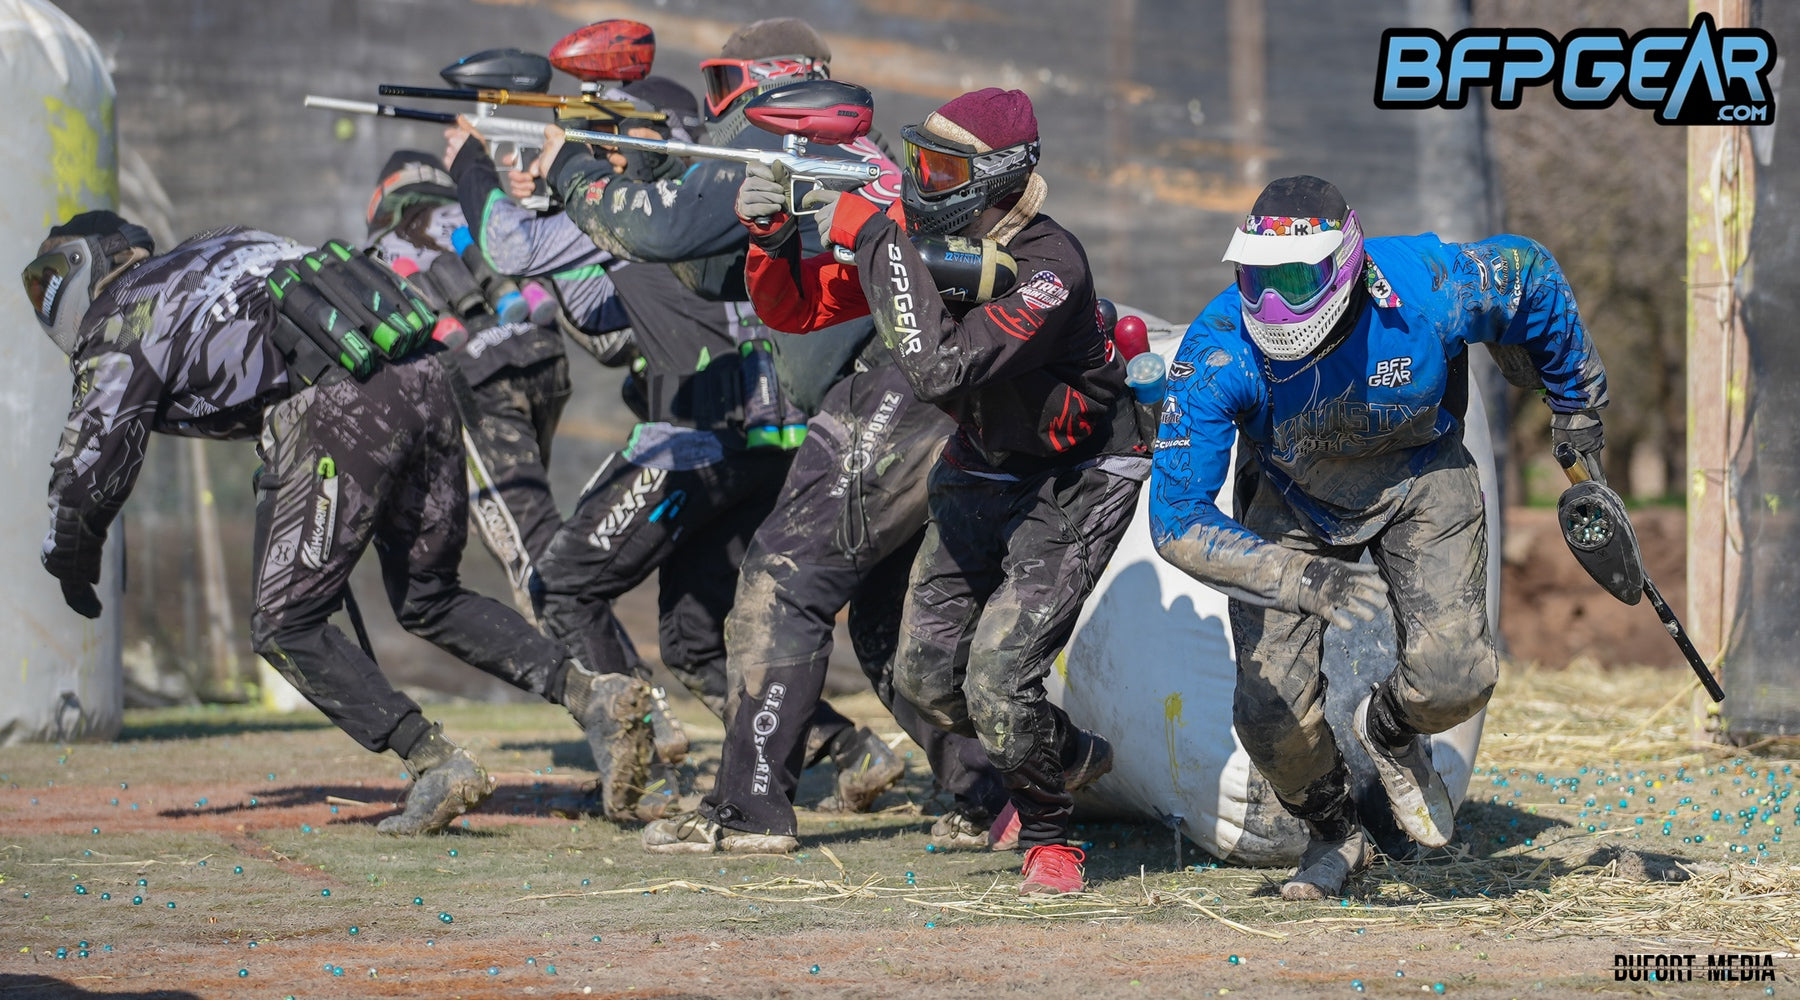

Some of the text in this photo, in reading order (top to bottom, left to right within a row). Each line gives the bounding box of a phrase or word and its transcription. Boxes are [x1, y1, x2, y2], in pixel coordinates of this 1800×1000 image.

[887, 243, 922, 356] BFPGEAR
[1368, 369, 1411, 388] GEAR
[1376, 357, 1412, 375] BFP
[861, 391, 900, 451] SPORTZ
[1273, 403, 1430, 451] YNASTY
